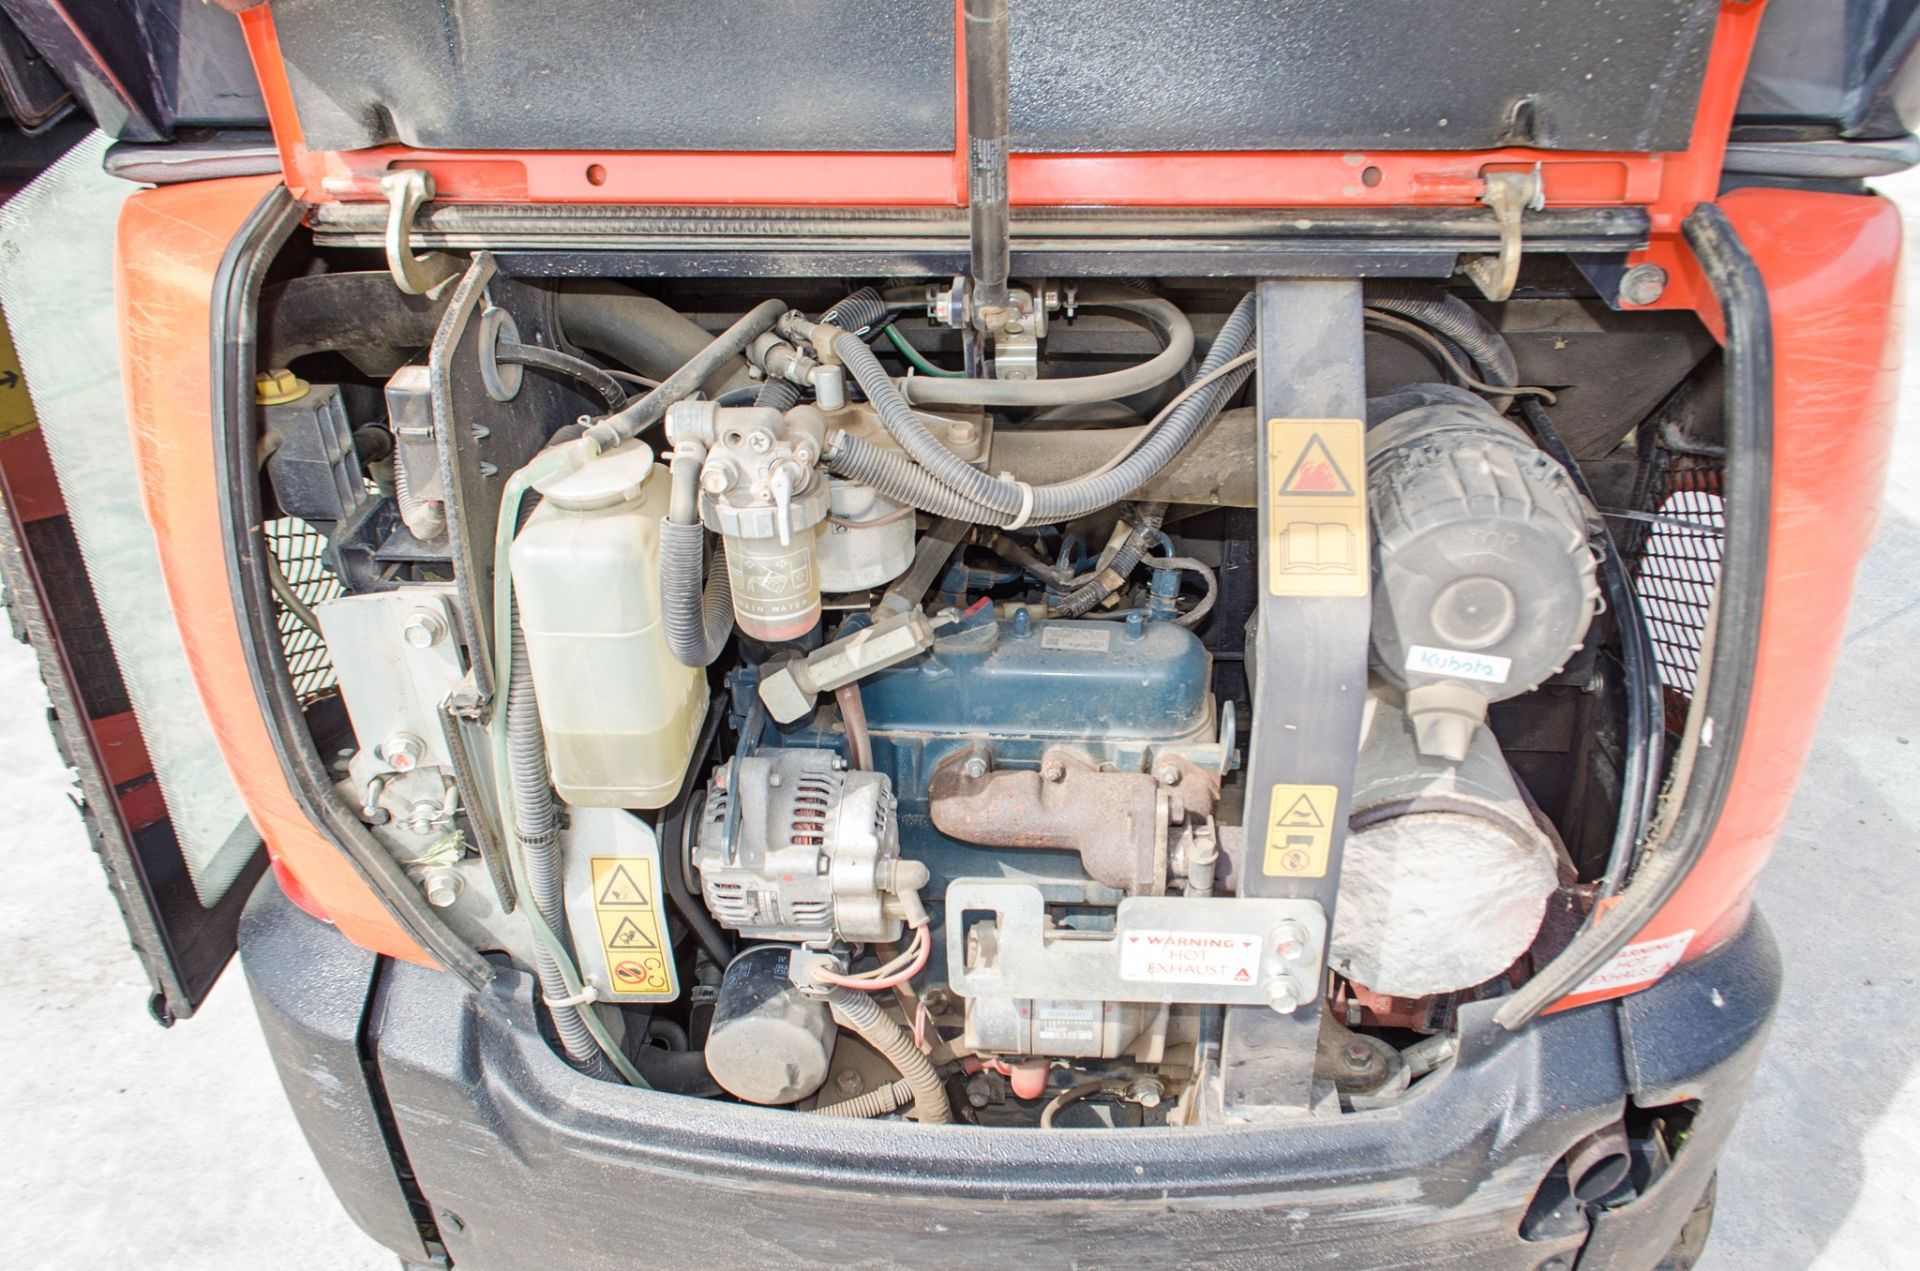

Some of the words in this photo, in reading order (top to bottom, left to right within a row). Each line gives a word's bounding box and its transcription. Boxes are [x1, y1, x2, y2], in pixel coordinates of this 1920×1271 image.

[1467, 528, 1520, 550] TOP
[771, 598, 808, 612] WATER
[1421, 651, 1496, 677] Kubota
[1147, 936, 1235, 949] WARNING
[1169, 950, 1208, 961] HOT
[1615, 941, 1673, 959] ARNING
[1147, 962, 1228, 976] EXHAUST
